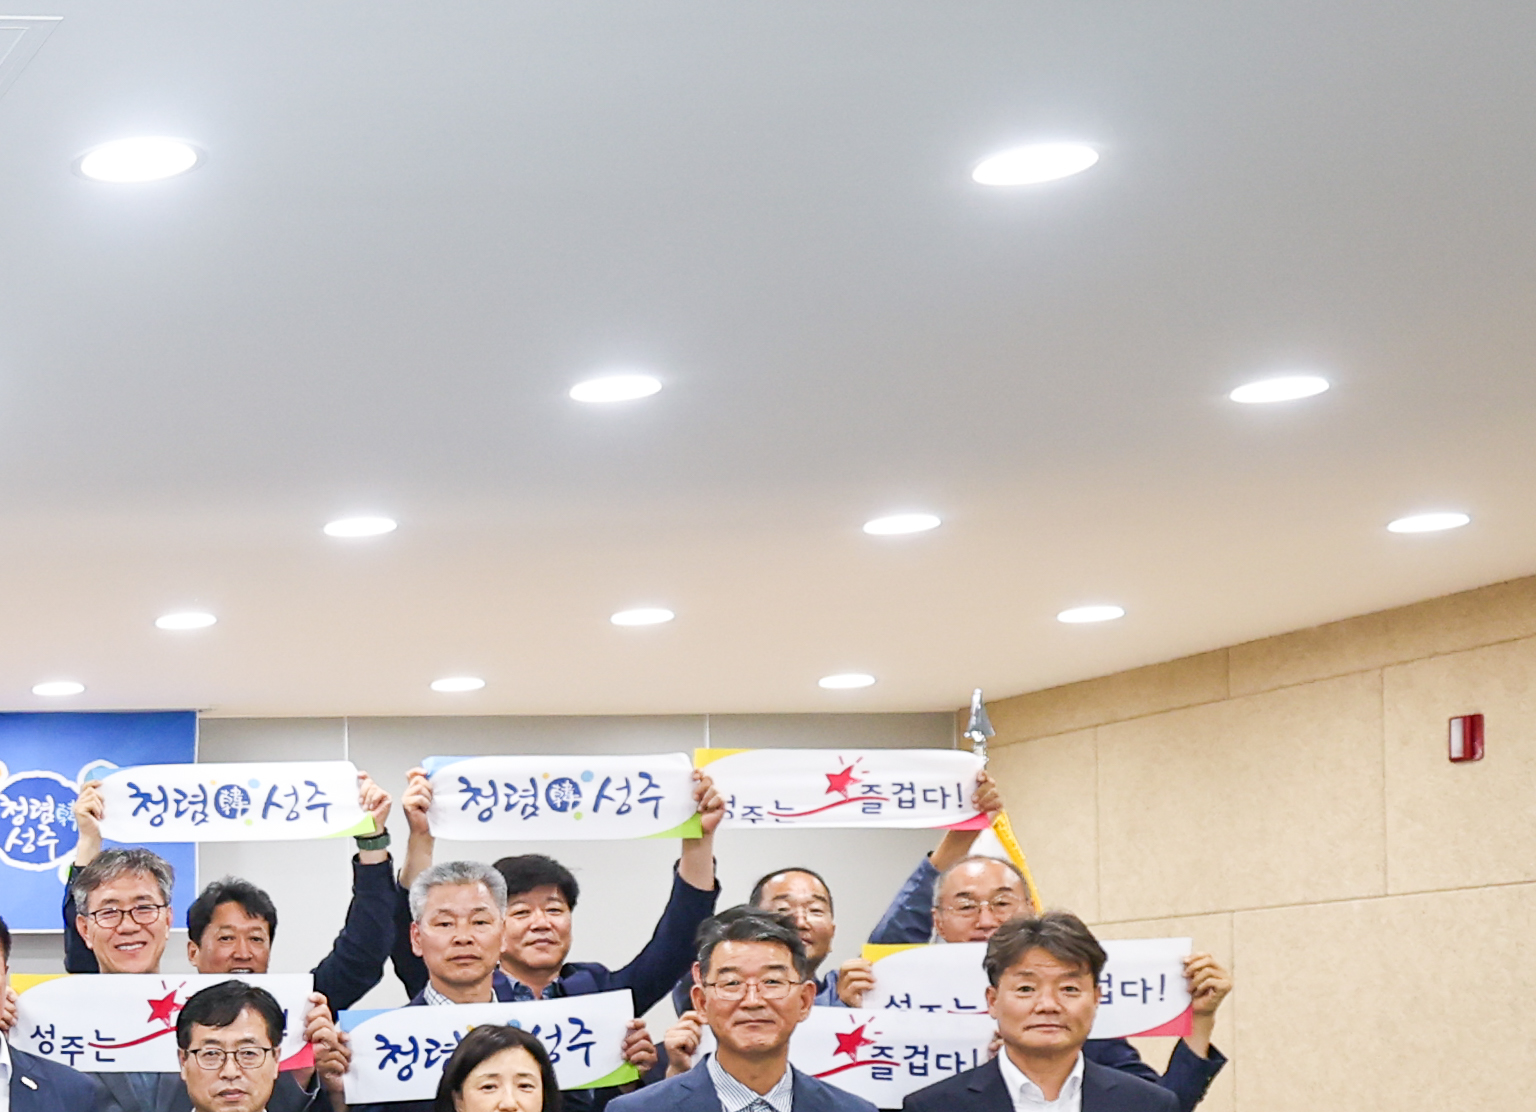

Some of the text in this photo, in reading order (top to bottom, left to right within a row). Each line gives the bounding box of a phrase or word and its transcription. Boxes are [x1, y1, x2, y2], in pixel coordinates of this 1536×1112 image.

[262, 780, 333, 824] 성주
[592, 771, 666, 820] 성주
[861, 782, 964, 814] 즐겁다!
[4, 824, 60, 862] 성주
[30, 1023, 116, 1067] 성주는
